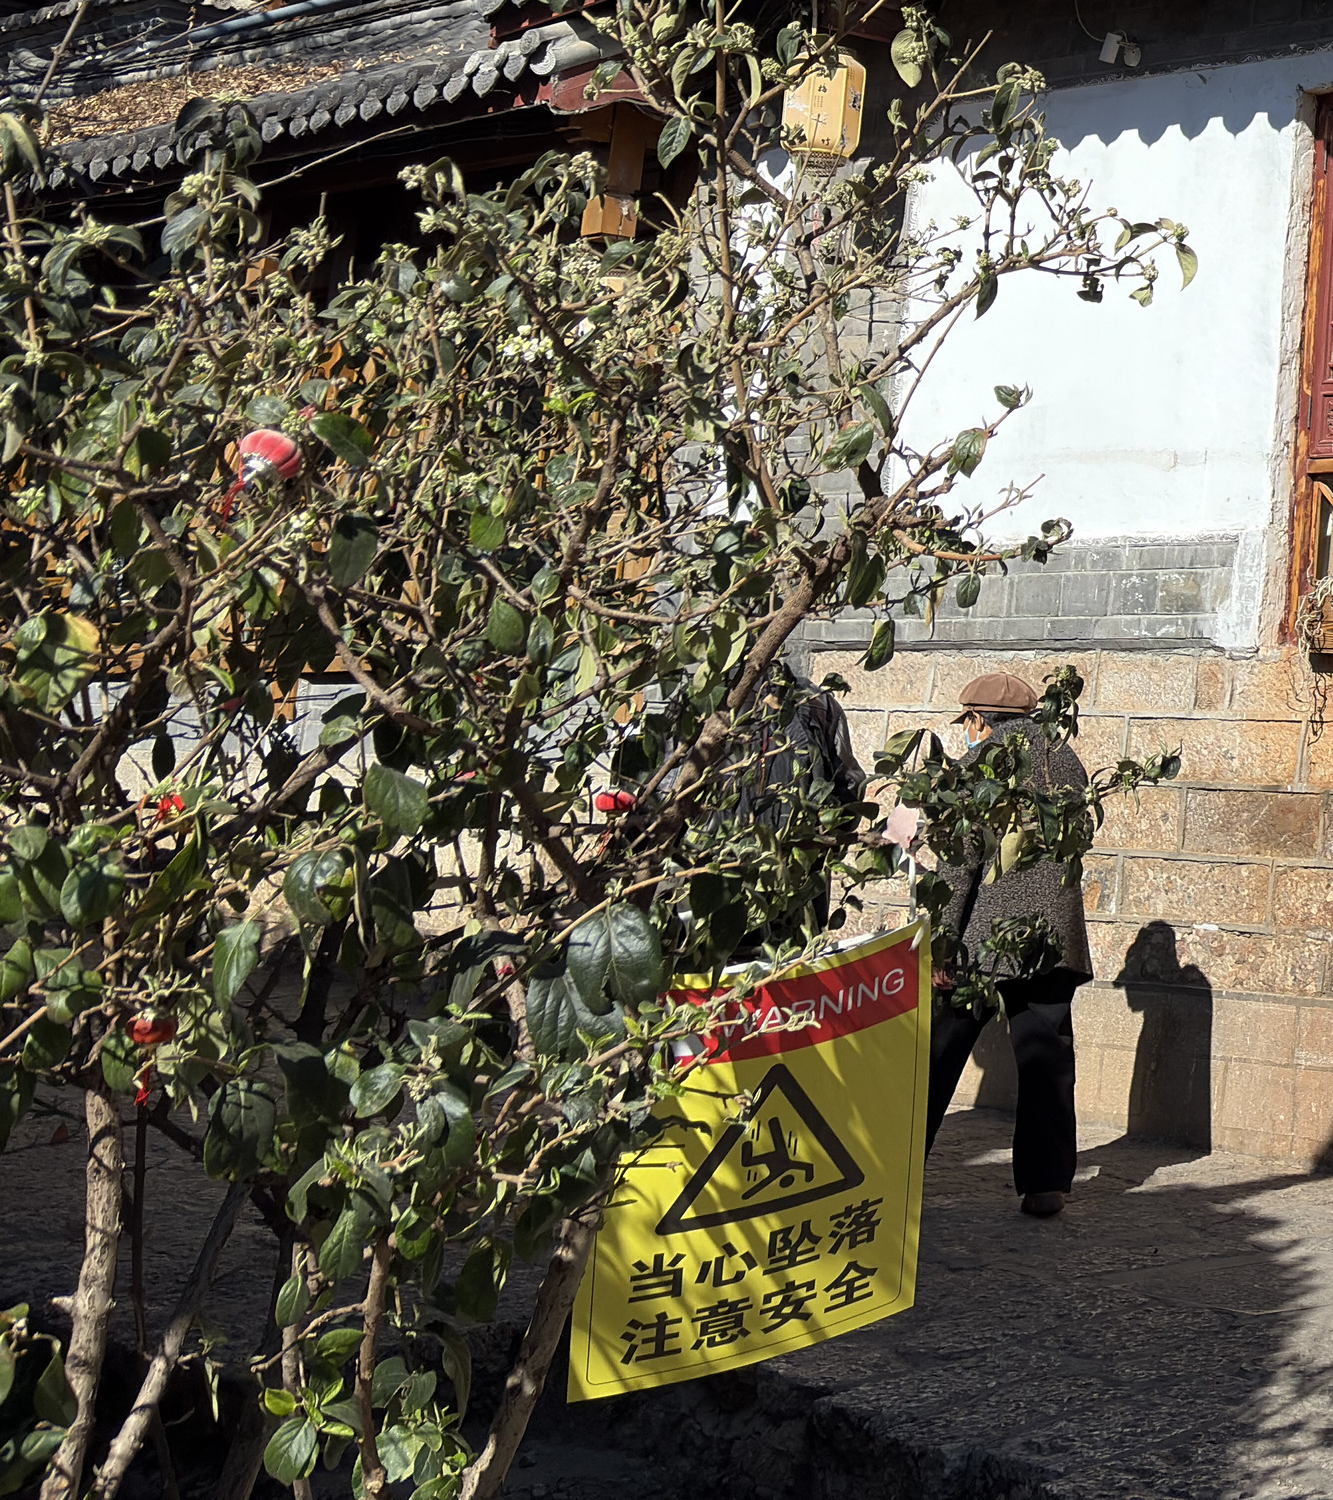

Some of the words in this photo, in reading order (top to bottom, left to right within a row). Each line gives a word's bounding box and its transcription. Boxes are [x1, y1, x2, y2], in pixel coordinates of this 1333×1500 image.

[627, 1197, 884, 1305] 当心坠落
[619, 1260, 879, 1366] 注意安全
